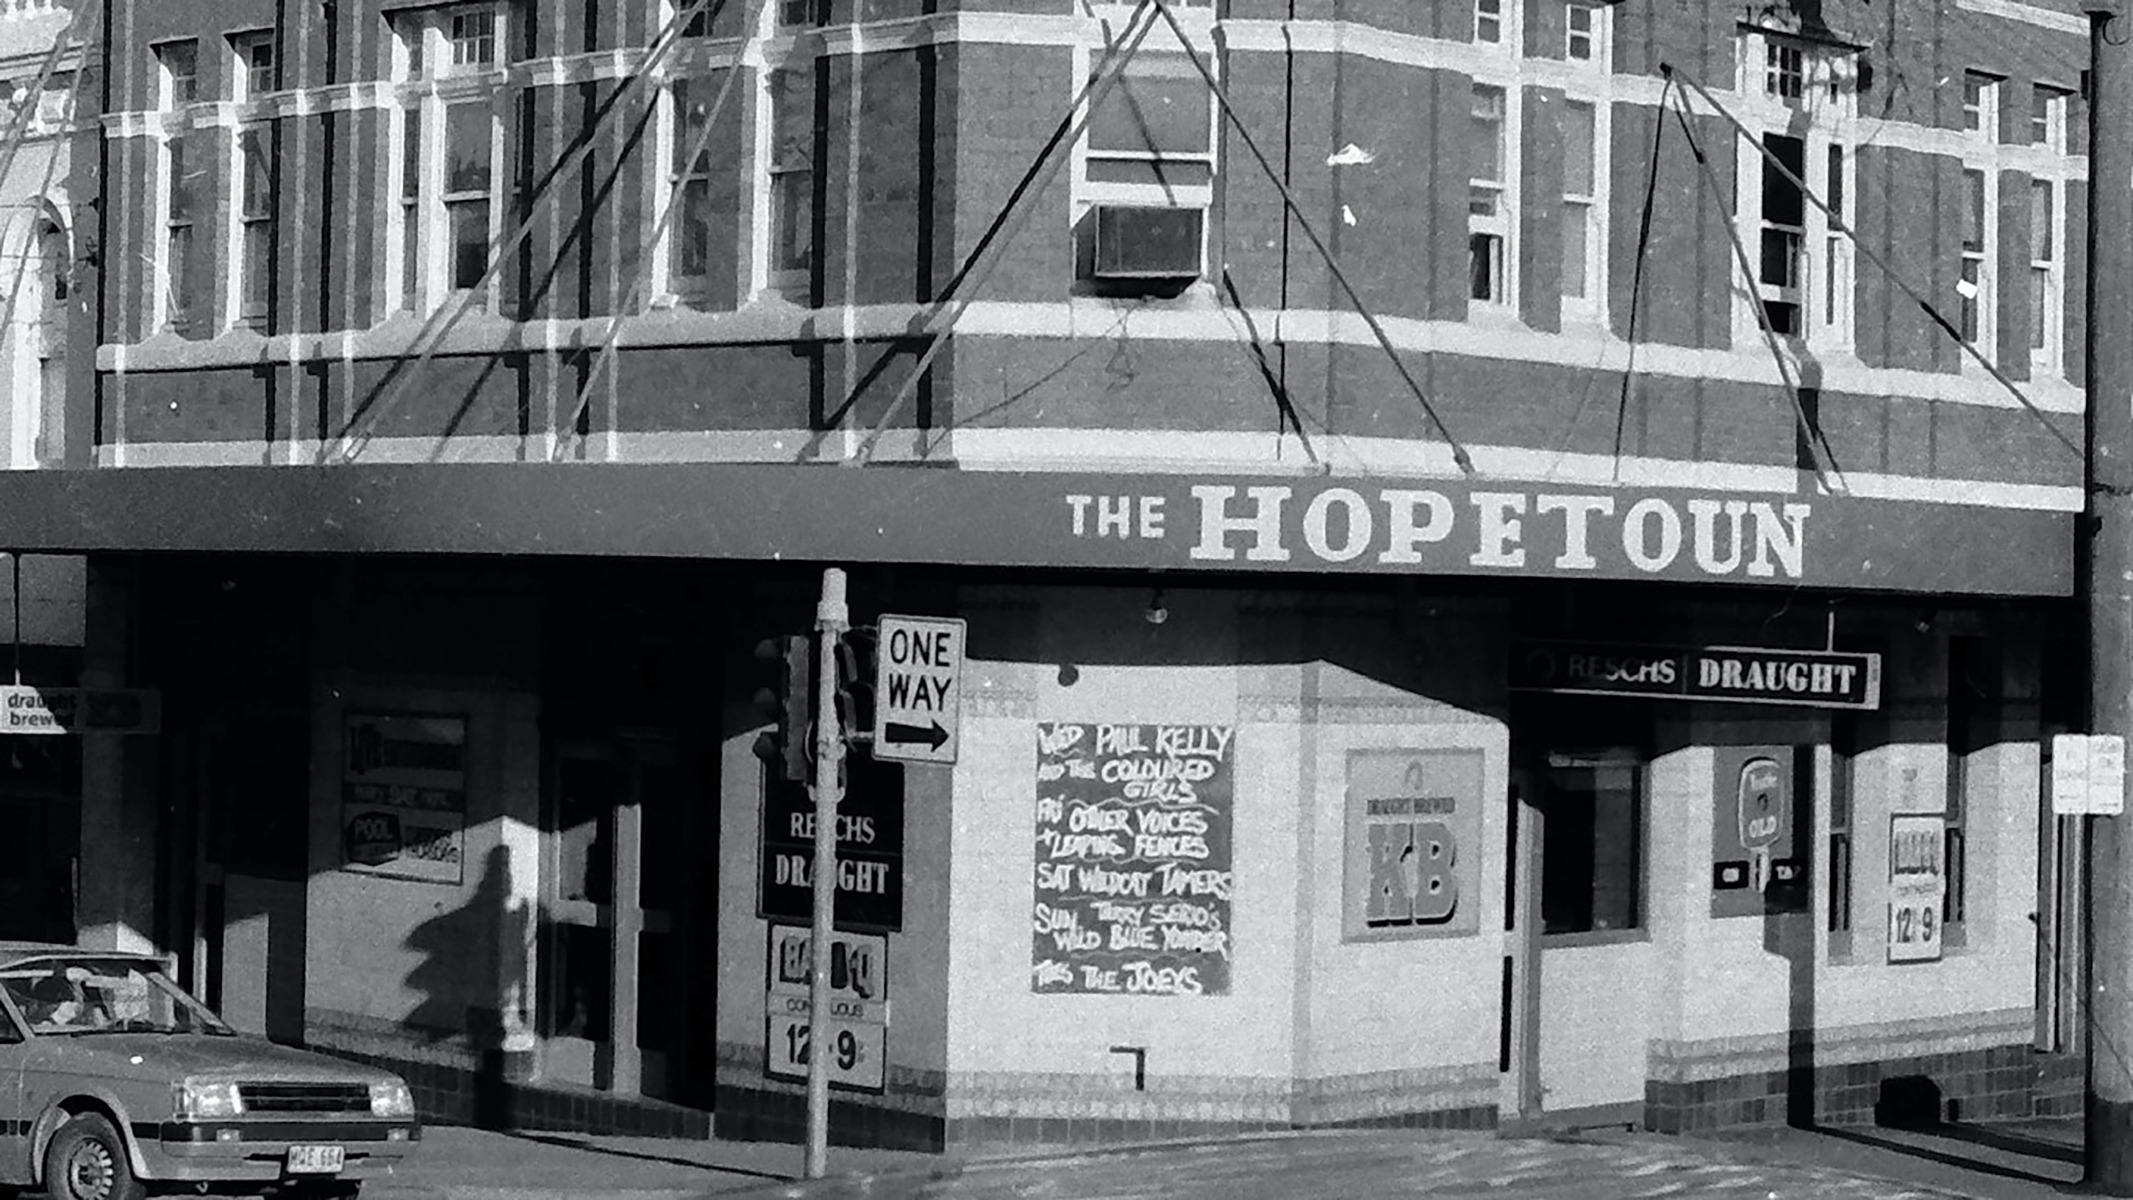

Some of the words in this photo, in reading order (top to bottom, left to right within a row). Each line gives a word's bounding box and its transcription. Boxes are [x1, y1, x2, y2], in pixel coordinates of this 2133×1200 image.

[1066, 494, 1166, 540] THE
[1189, 485, 1811, 578] HOPETOUN
[890, 628, 951, 668] ONE
[1568, 654, 1676, 684] RESCHS
[1699, 657, 1857, 694] DRAUGHT
[888, 673, 953, 712] WAY
[1096, 724, 1149, 756] PAUL
[1155, 726, 1233, 761] KELLY
[1101, 759, 1215, 783] COLOURED
[1123, 780, 1197, 804] GIRLS
[353, 817, 394, 842] POOL
[790, 811, 876, 844] RECHS
[1069, 805, 1135, 837] OTHER
[1136, 808, 1209, 835] VOICES
[1749, 814, 1777, 840] OLD
[1135, 834, 1210, 859] FENCES
[775, 854, 889, 894] DRGHT
[1366, 822, 1459, 928] KB
[1052, 923, 1101, 951] WILD
[1108, 924, 1159, 951] BLUE
[1922, 906, 1934, 942] 9
[1080, 965, 1122, 990] THE
[1121, 960, 1204, 996] JOEYS
[786, 1023, 811, 1065] 12
[837, 1030, 857, 1071] 9
